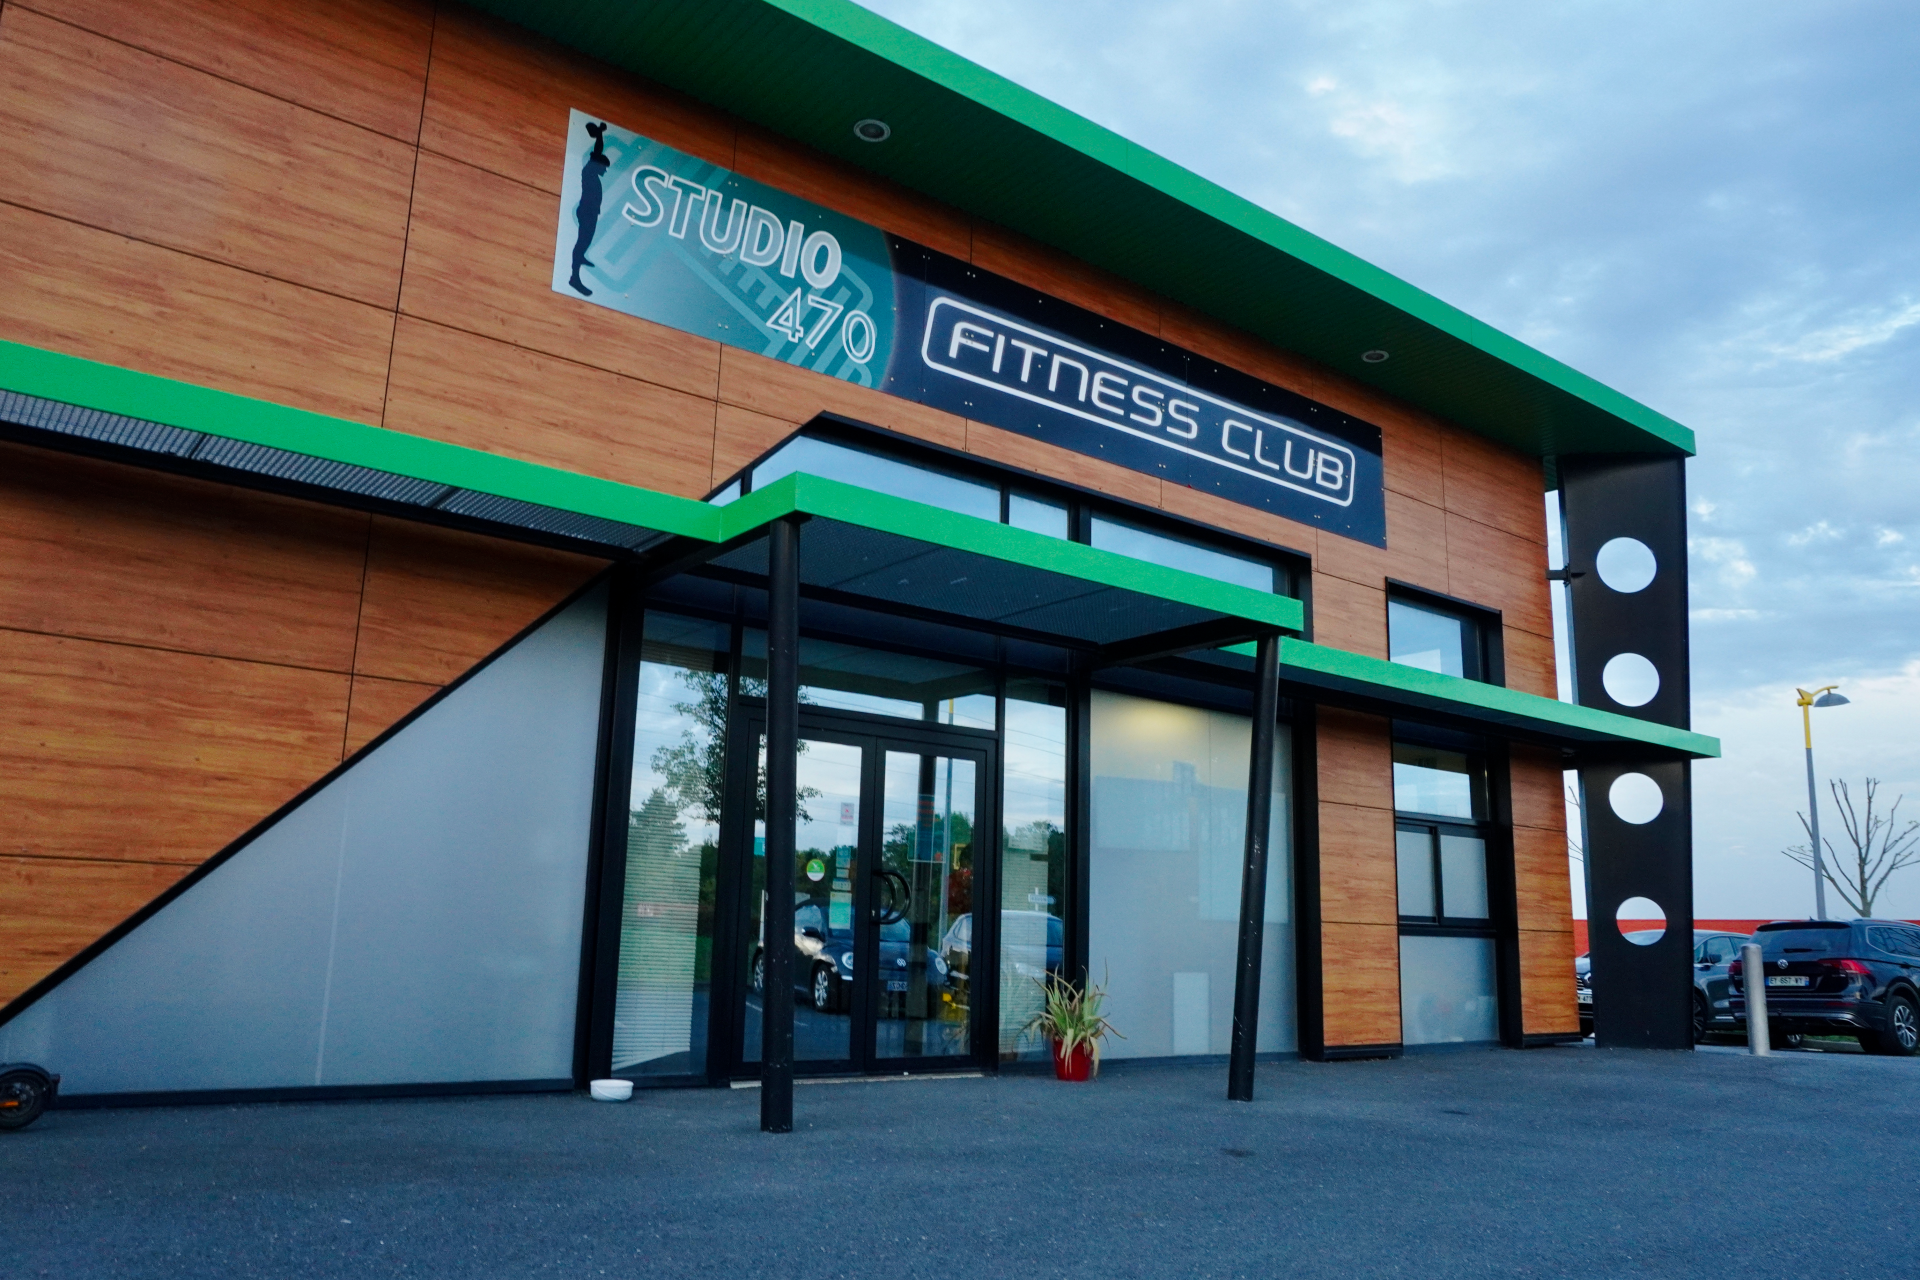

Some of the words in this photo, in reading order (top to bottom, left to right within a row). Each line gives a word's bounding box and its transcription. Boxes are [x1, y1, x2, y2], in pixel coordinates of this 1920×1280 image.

[622, 164, 842, 289] STUDIO
[766, 287, 876, 364] 470
[948, 321, 1200, 440] FITNESS
[1221, 418, 1344, 490] CLUB
